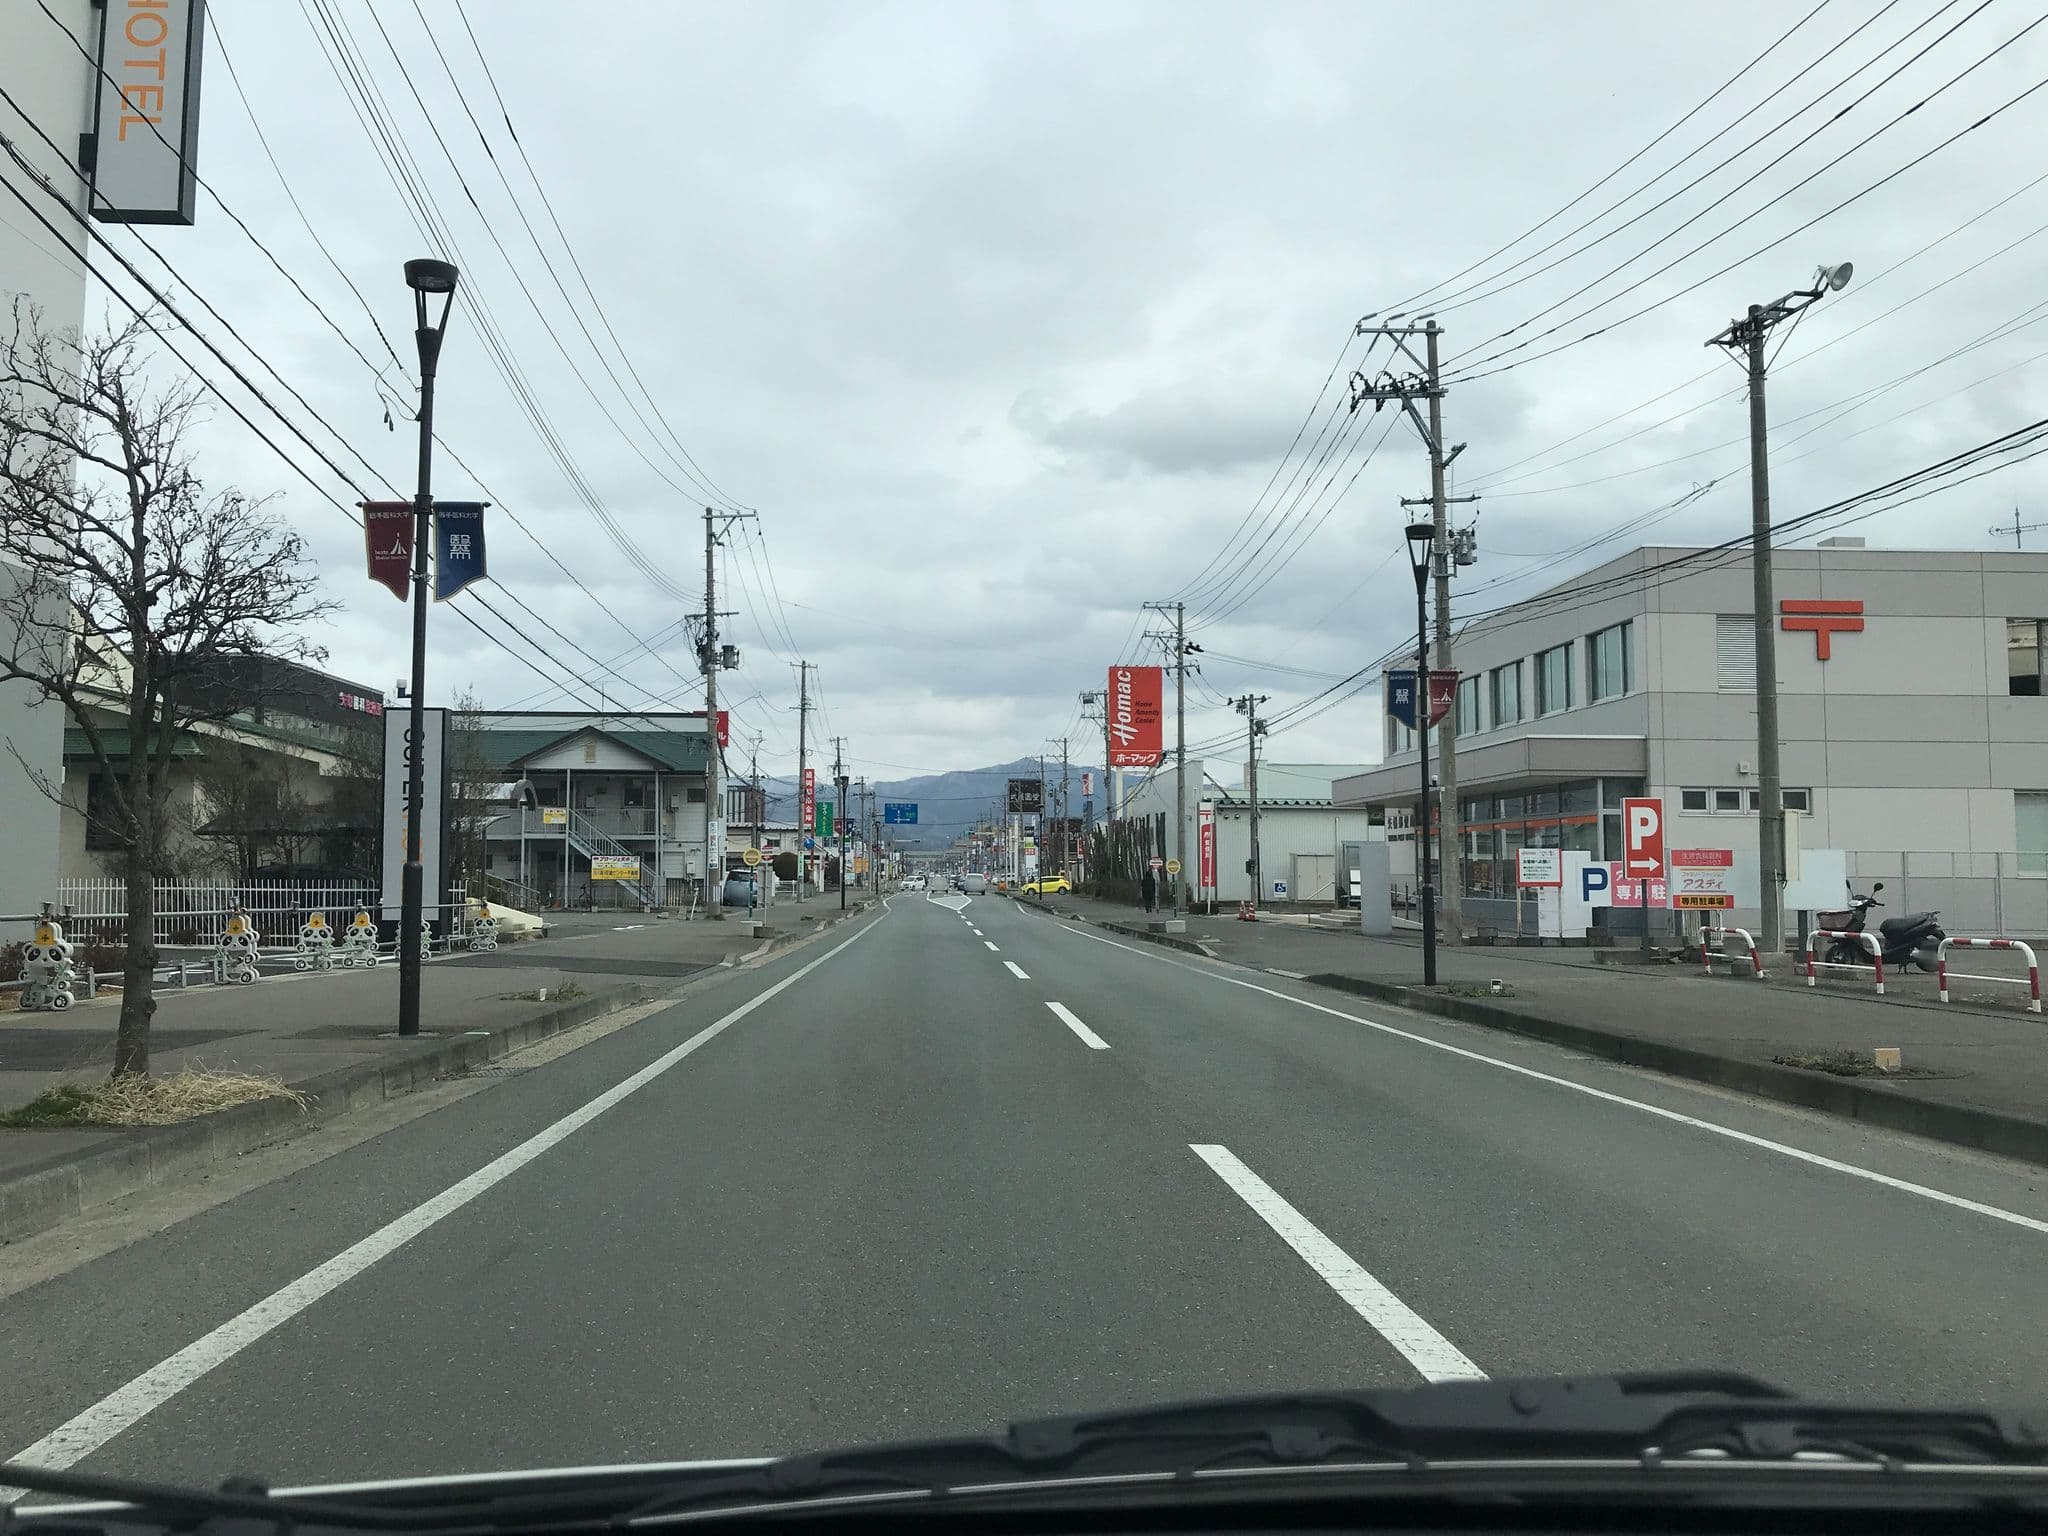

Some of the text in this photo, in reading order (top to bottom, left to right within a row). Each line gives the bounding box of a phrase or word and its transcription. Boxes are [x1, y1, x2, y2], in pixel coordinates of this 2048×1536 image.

[119, 0, 168, 142] OTEL
[1111, 670, 1139, 746] Homac
[1115, 753, 1157, 763] ホーマック
[1630, 806, 1659, 850] P
[1582, 867, 1609, 902] P
[1681, 897, 1725, 906] 専用駐車場
[1683, 879, 1724, 890] アスティ
